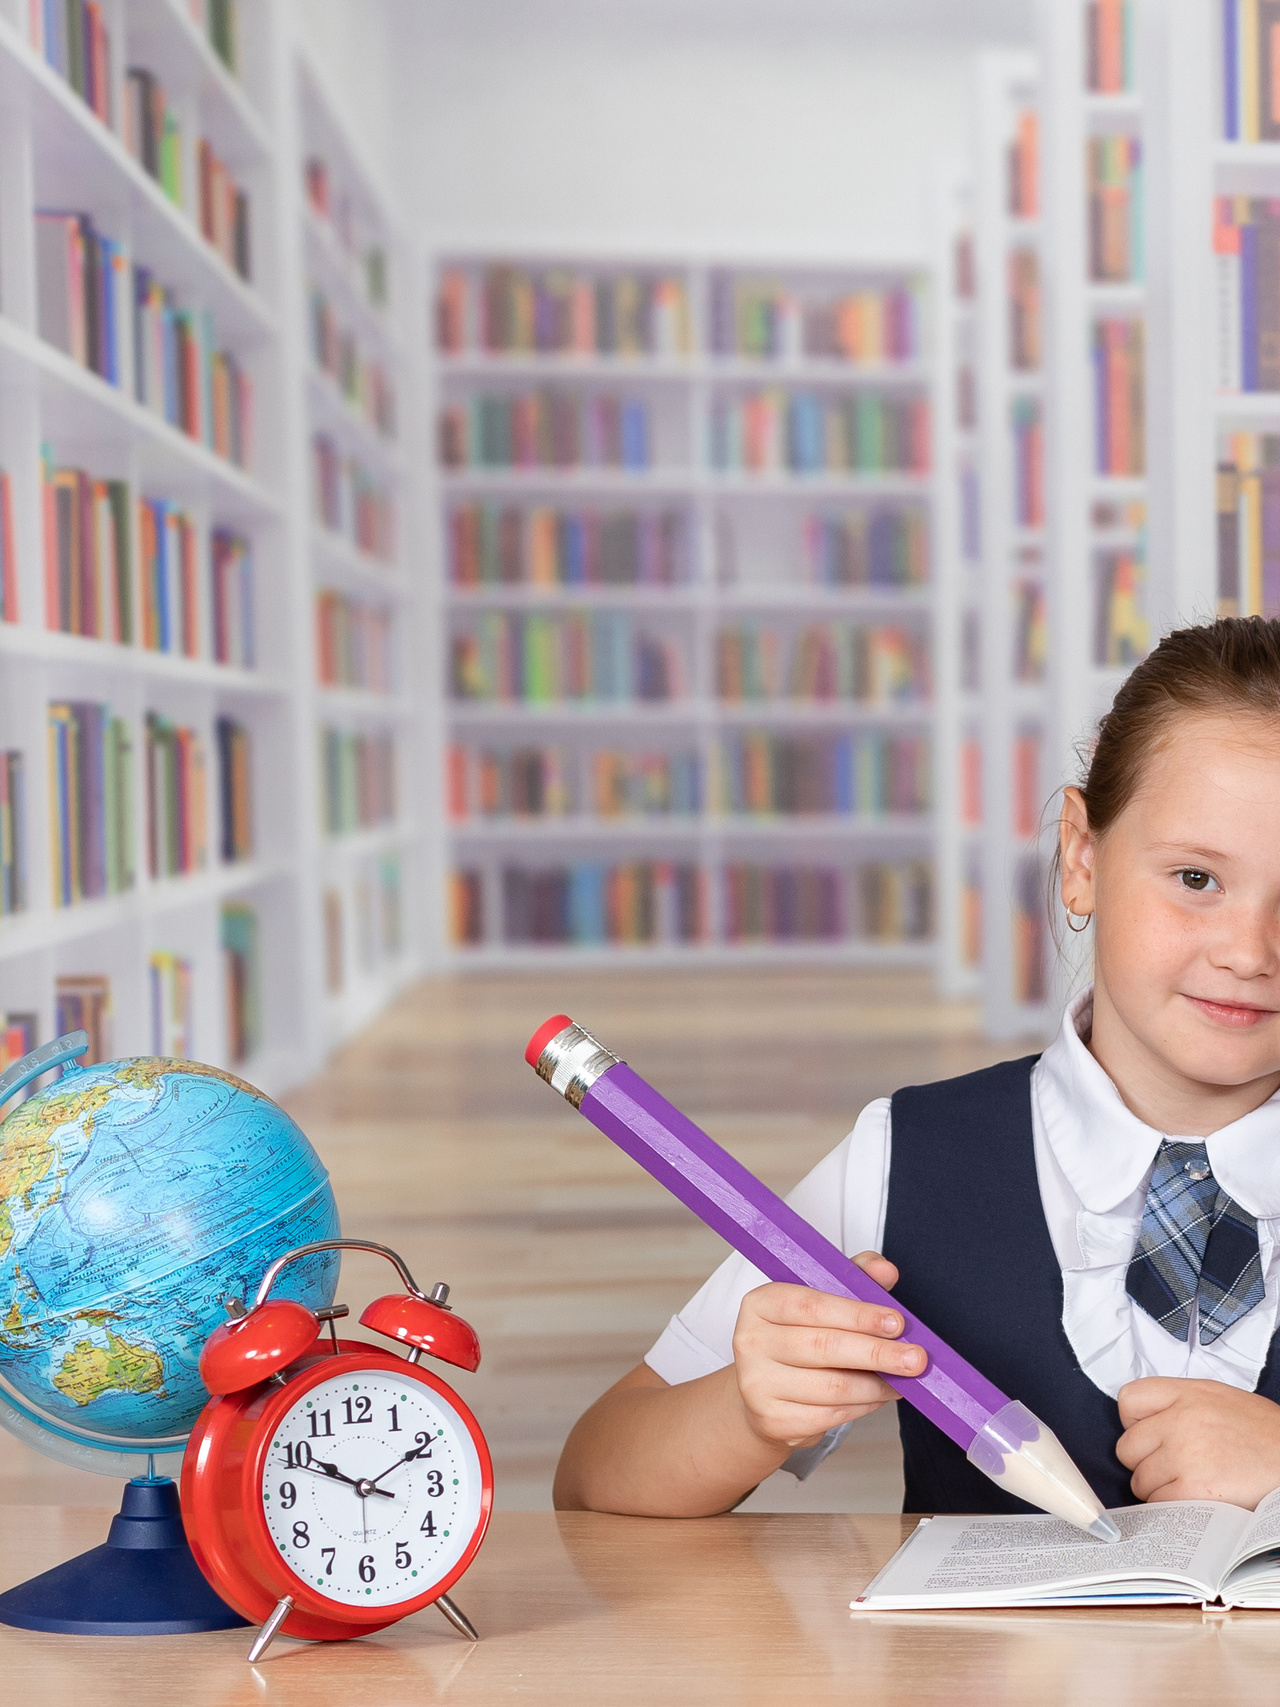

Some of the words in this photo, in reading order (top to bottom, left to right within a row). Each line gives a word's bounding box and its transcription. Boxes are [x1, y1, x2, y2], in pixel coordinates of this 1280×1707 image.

[307, 1409, 335, 1438] 11
[342, 1396, 373, 1424] 12
[387, 1404, 402, 1432] 1
[283, 1441, 312, 1469] 10
[414, 1431, 433, 1459] 2
[280, 1481, 297, 1509] 9
[427, 1470, 444, 1497] 3
[292, 1521, 310, 1548] 8
[420, 1510, 438, 1537] 4
[321, 1548, 336, 1575] 7
[395, 1541, 412, 1568] 5
[359, 1555, 376, 1582] 6
